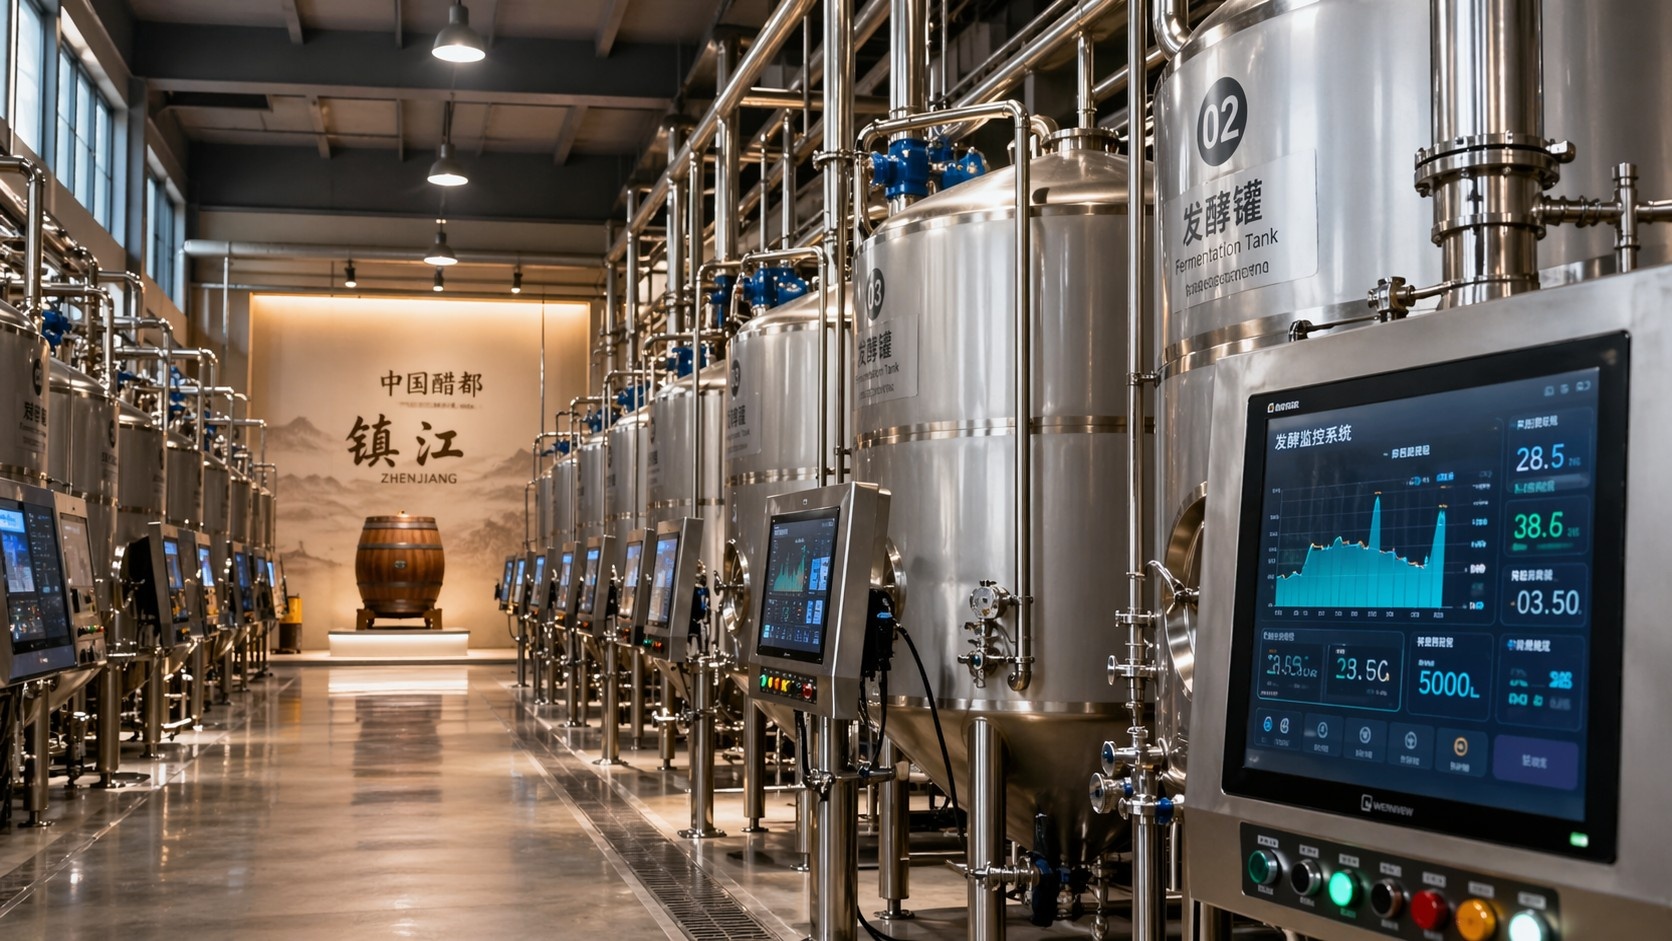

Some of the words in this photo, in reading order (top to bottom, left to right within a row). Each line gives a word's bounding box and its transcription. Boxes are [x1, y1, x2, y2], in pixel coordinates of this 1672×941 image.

[1202, 95, 1240, 150] 02
[1183, 179, 1263, 246] 发酵罐
[1175, 241, 1241, 276] Fermentation
[1245, 227, 1279, 251] Tank
[868, 279, 881, 310] 03
[380, 369, 483, 398] 中国醋都
[345, 413, 464, 468] 镇江
[1275, 424, 1352, 451] 发酵监控系统
[1516, 443, 1565, 472] 28.5
[381, 473, 457, 485] ZHENJIANG
